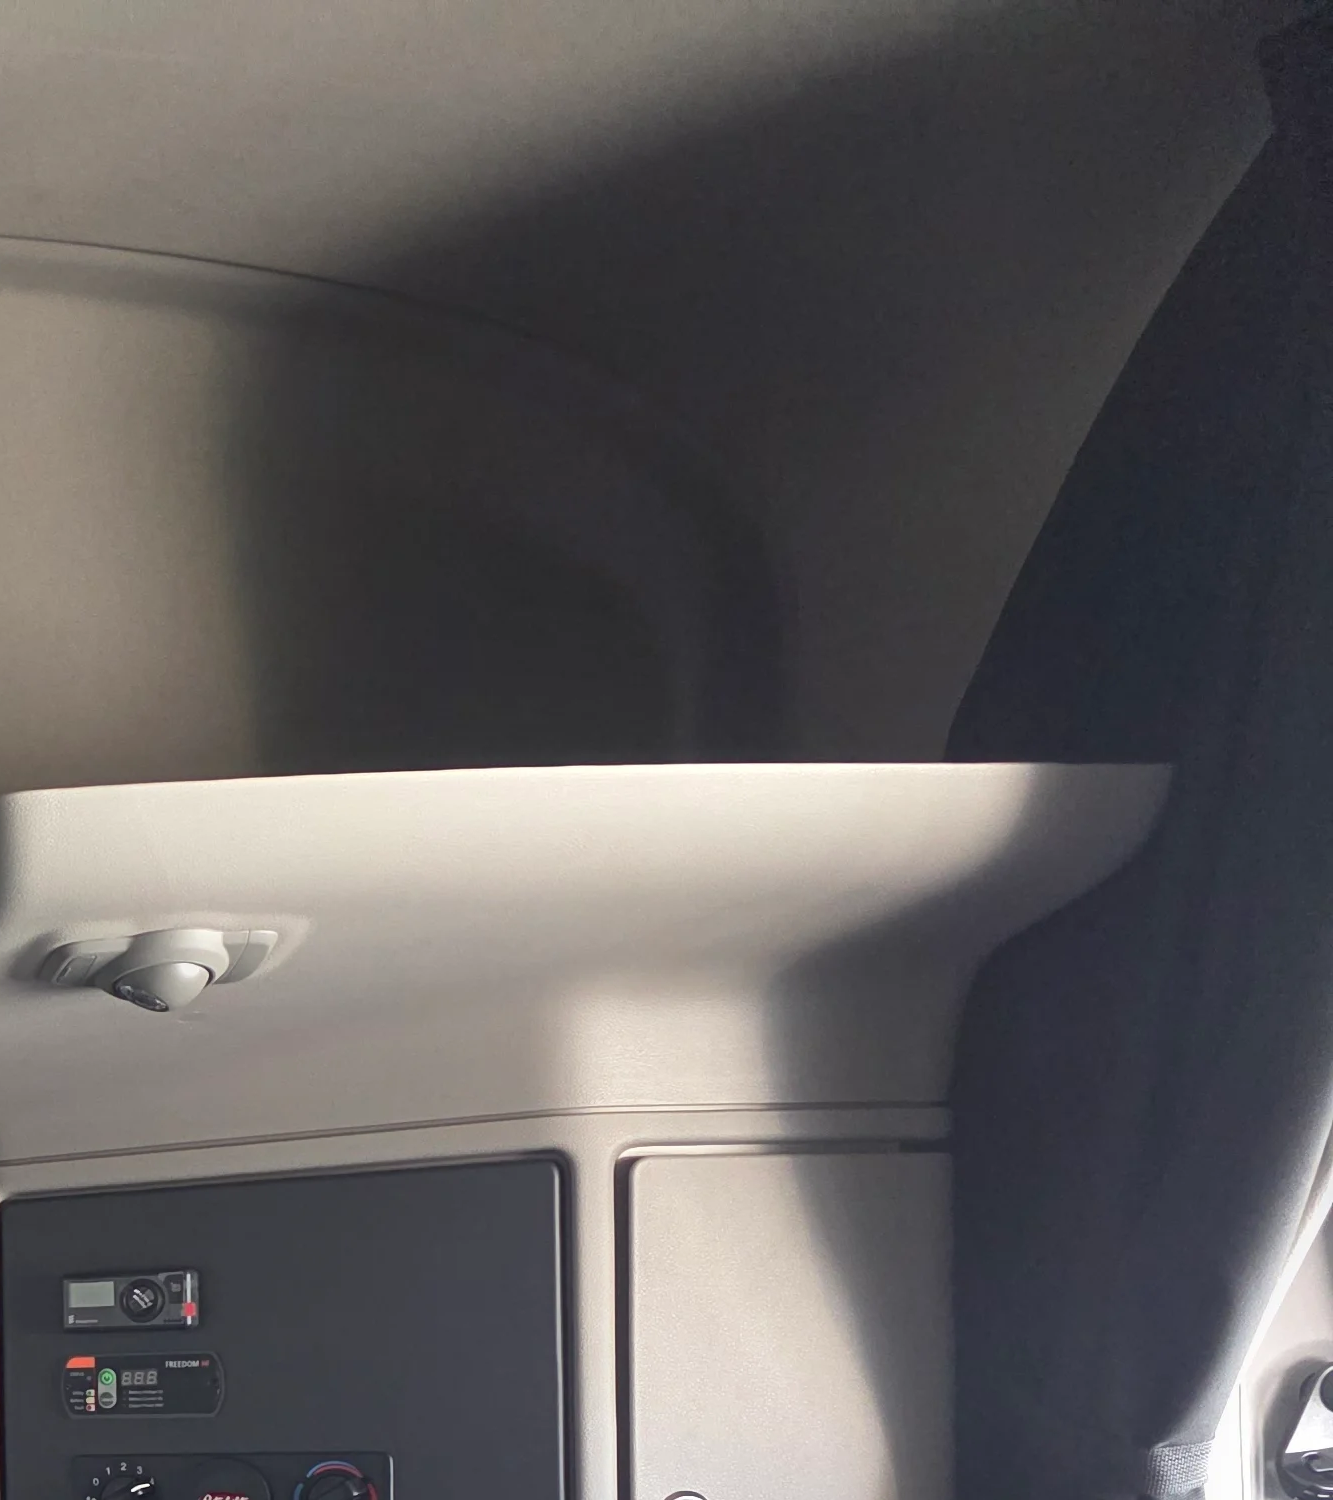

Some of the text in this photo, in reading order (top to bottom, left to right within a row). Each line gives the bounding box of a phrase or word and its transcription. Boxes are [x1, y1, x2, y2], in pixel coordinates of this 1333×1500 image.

[165, 1360, 200, 1369] FREEDOM
[92, 1477, 100, 1486] 0
[105, 1466, 111, 1476] 1
[120, 1461, 127, 1471] 2
[136, 1465, 143, 1475] 3
